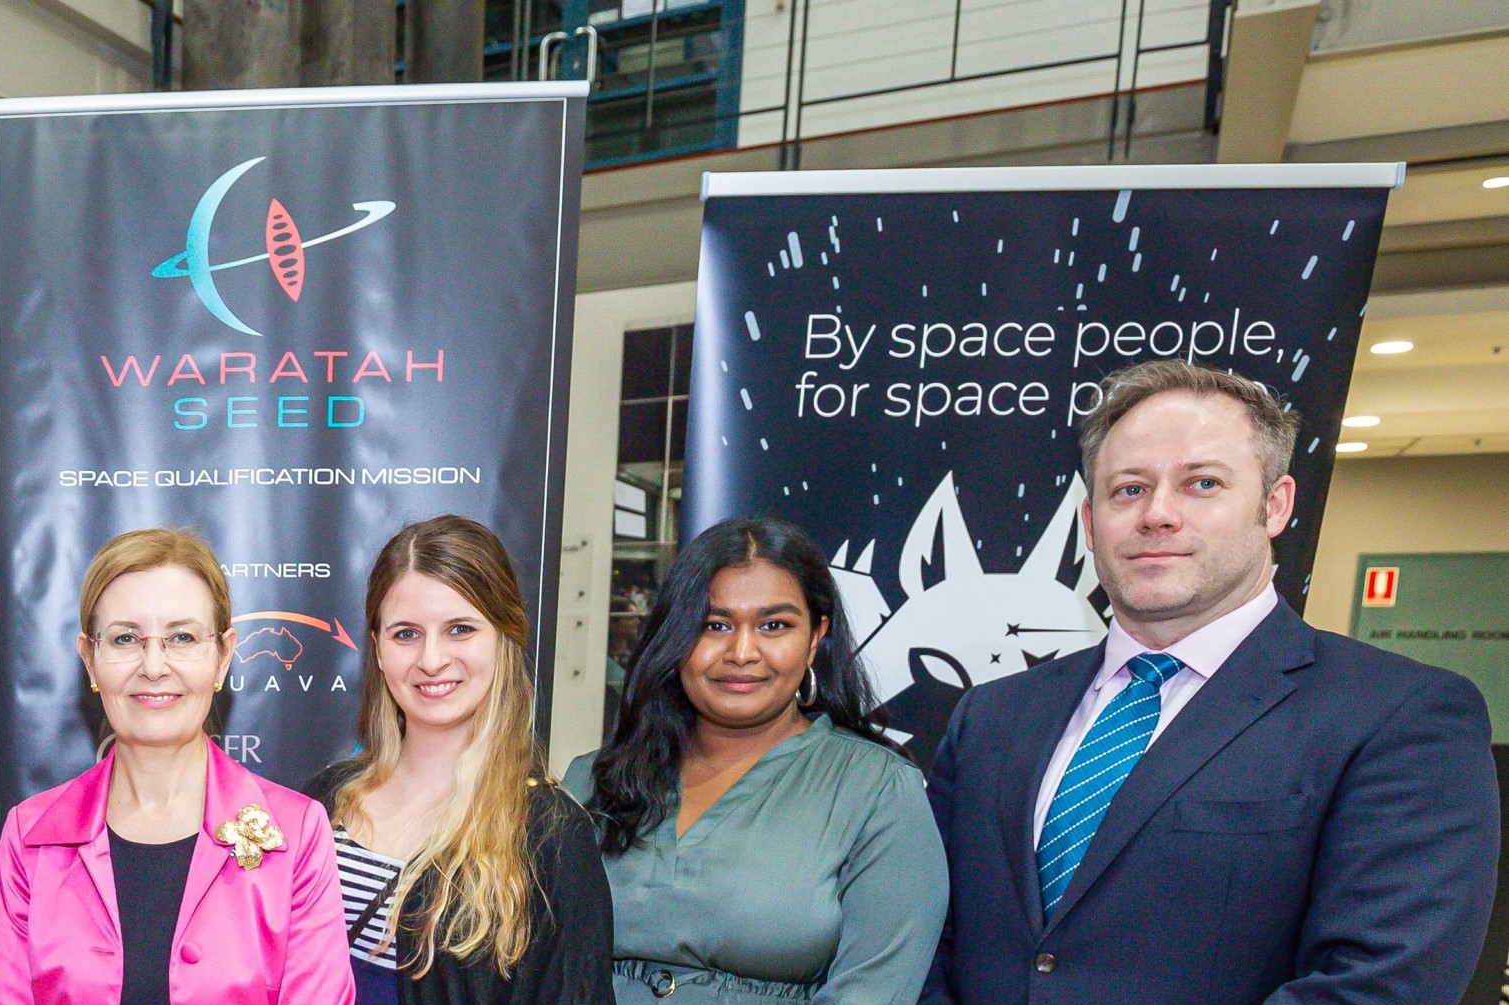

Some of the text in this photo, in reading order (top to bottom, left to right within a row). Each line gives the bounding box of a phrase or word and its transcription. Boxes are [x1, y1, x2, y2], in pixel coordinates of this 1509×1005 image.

[804, 307, 1286, 369] By space people,
[100, 349, 445, 387] WARATAH
[173, 396, 366, 430] SEED
[794, 371, 870, 418] for
[884, 381, 1050, 427] space
[59, 467, 481, 487] SPACE QUALIFICATION MISSION
